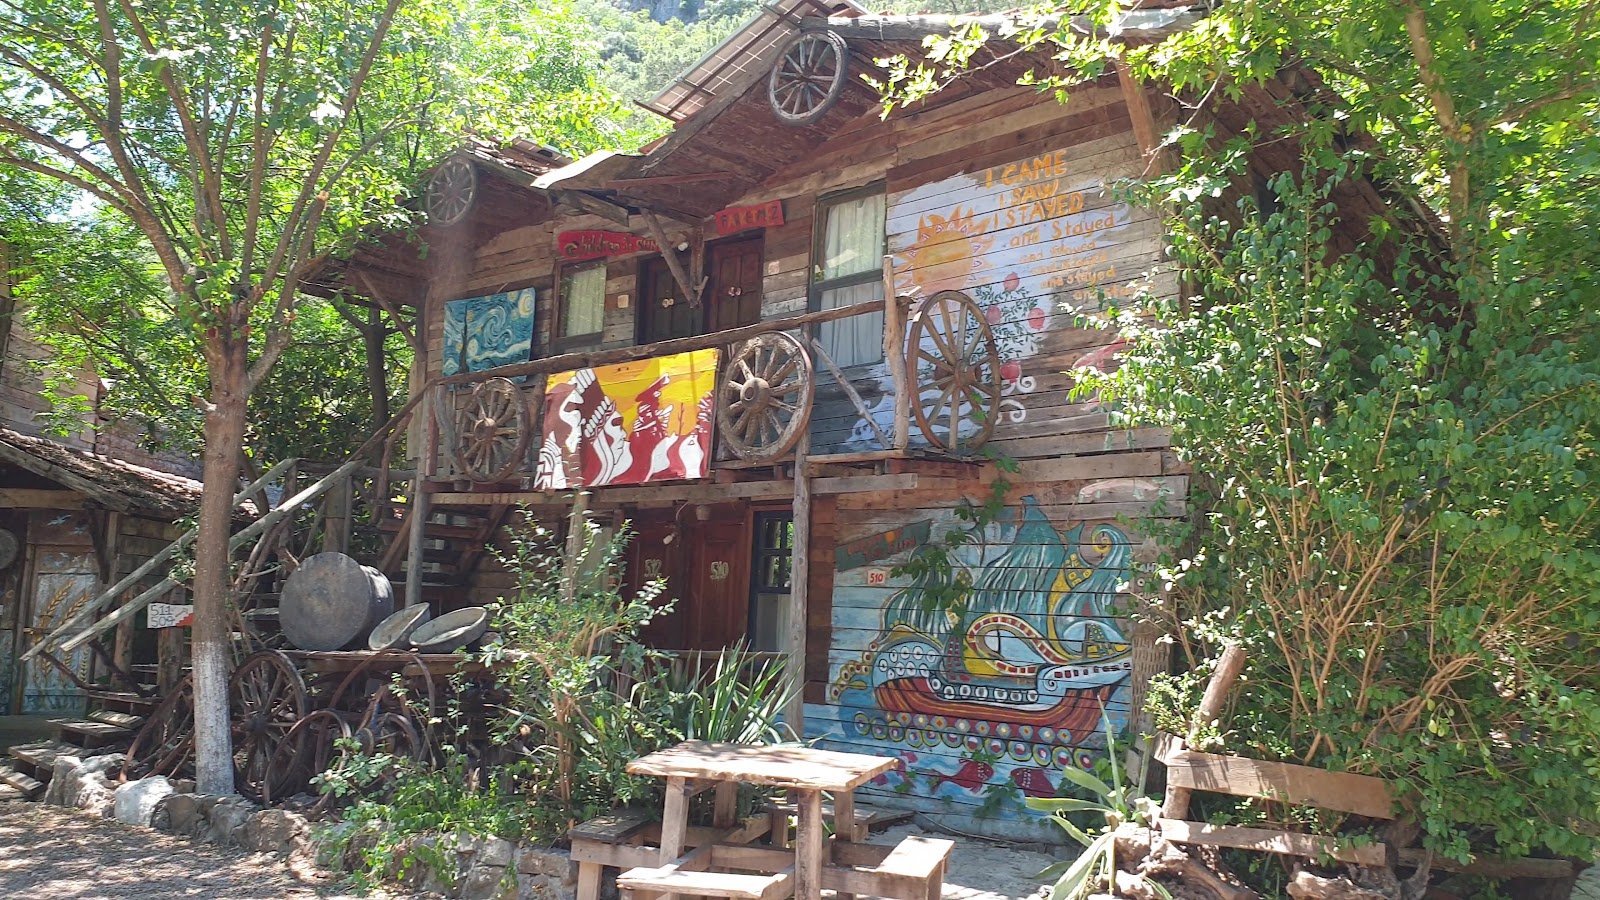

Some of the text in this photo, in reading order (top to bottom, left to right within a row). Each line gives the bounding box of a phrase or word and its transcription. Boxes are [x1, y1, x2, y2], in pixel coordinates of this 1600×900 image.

[985, 152, 1067, 189] I CAME
[1010, 179, 1059, 206] SAW
[1006, 193, 1084, 227] STAYED
[1009, 225, 1041, 247] and
[869, 573, 884, 584] 510
[150, 604, 173, 616] 511
